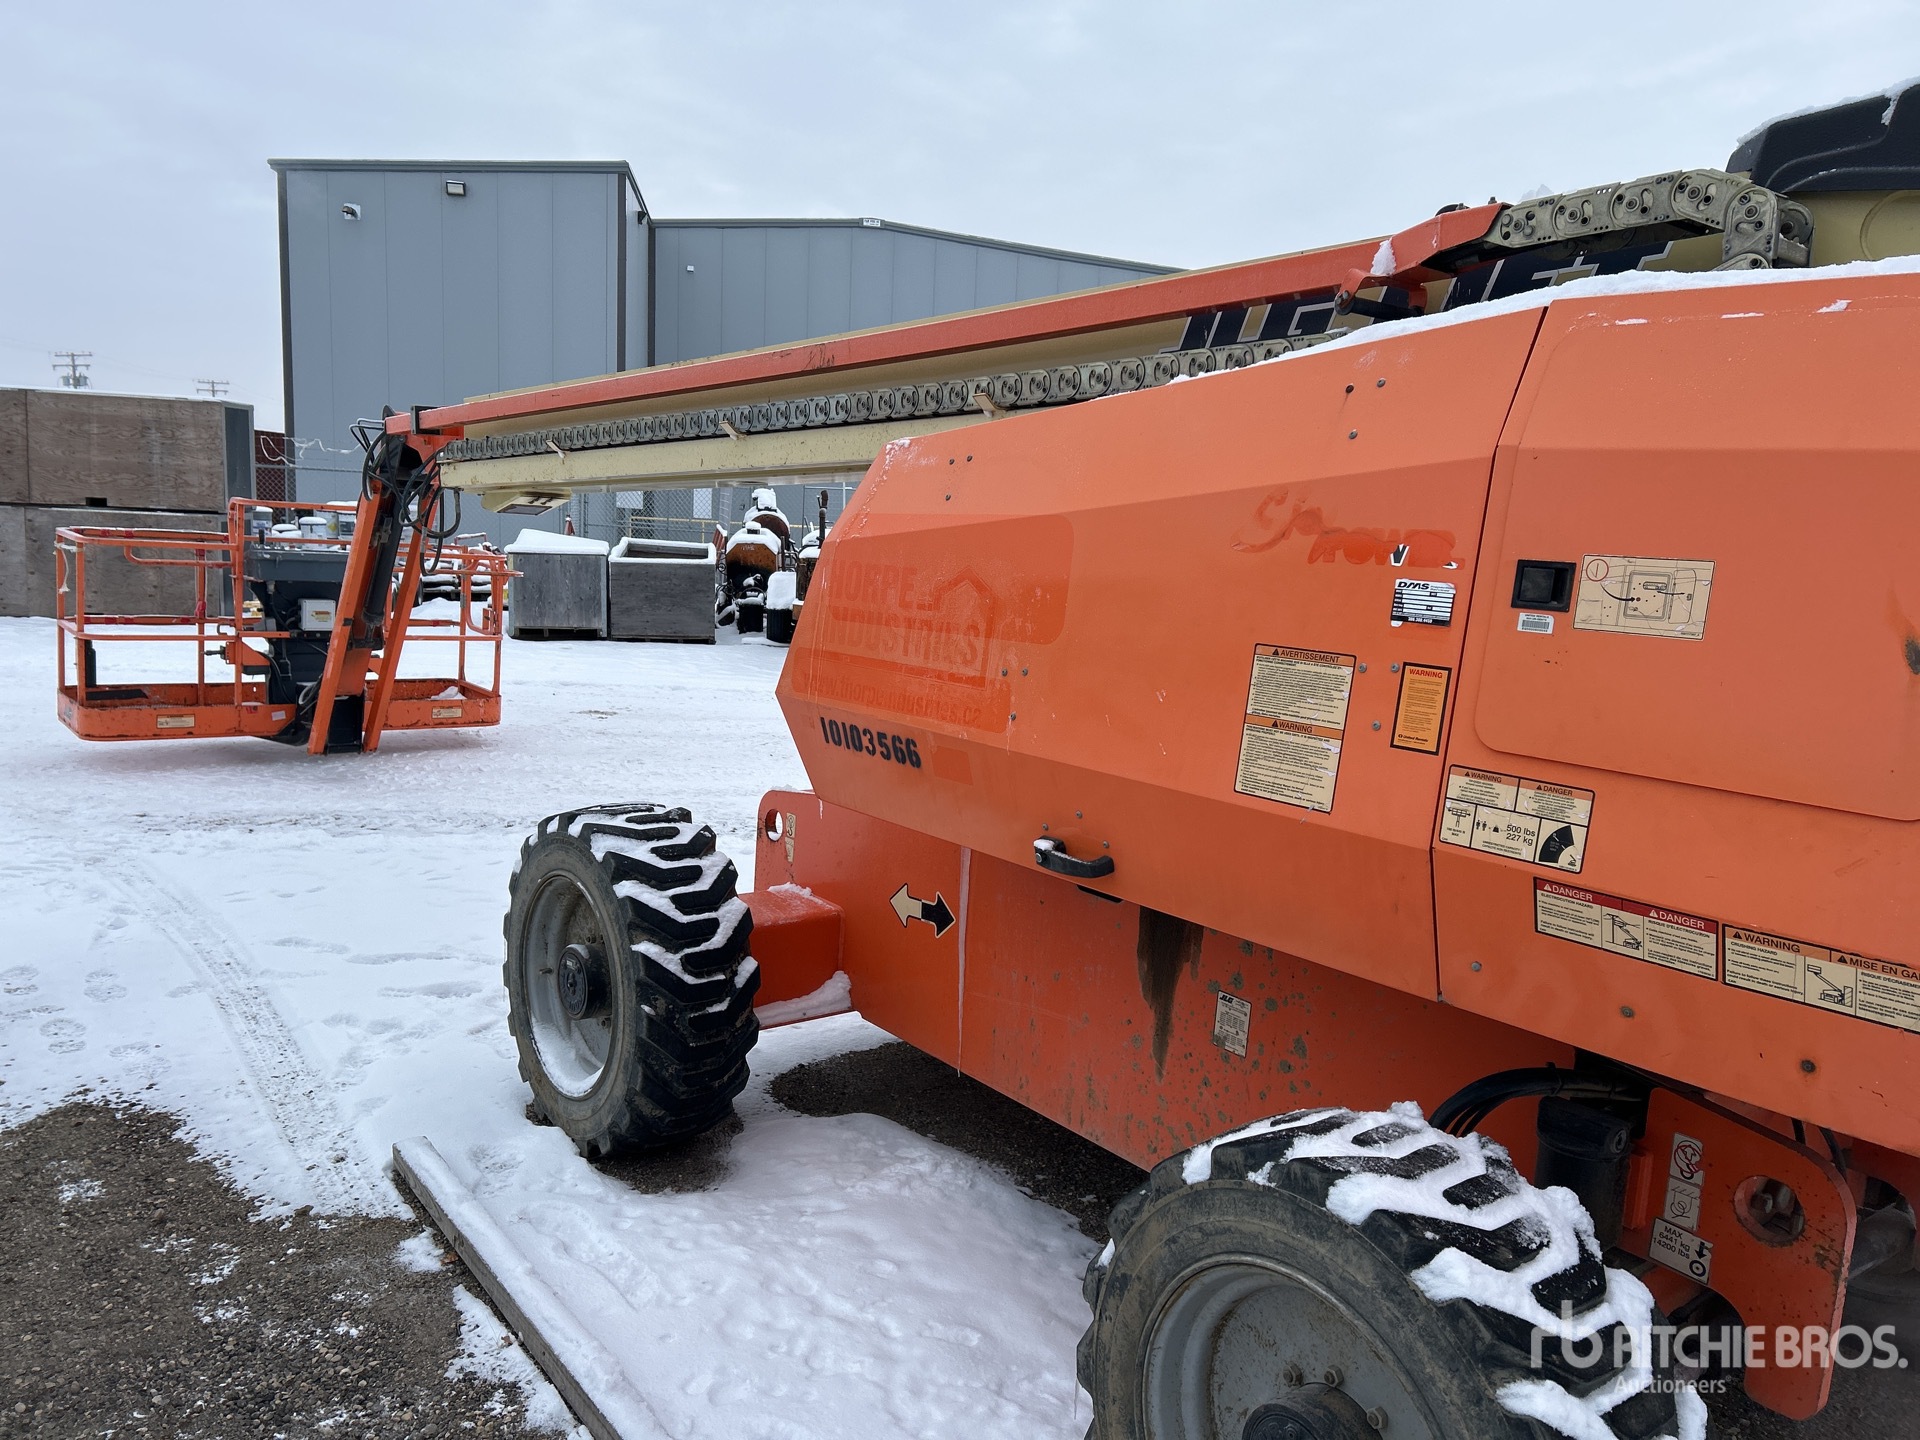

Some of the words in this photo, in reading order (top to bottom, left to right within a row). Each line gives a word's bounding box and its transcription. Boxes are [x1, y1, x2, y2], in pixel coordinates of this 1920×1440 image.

[1397, 581, 1430, 590] DMS
[1280, 649, 1340, 664] AVERTISSEMENT
[1409, 668, 1443, 679] WARNING
[1278, 720, 1313, 734] WARNING
[820, 716, 922, 769] 10103566
[1470, 771, 1502, 783] WARNING
[1543, 785, 1573, 796] DANGER
[1506, 824, 1522, 834] 500
[1523, 828, 1536, 837] lbs
[1506, 833, 1521, 842] 227
[1523, 836, 1533, 847] kg
[1552, 885, 1593, 902] DANGER
[1659, 911, 1705, 930] DANGER
[1744, 932, 1800, 953] WARNING
[1757, 946, 1778, 956] HAZARD
[1849, 957, 1878, 971] MISE
[1882, 964, 1898, 975] EN
[1219, 994, 1234, 1004] JLG
[1664, 1225, 1683, 1240] MAX
[1653, 1237, 1677, 1253] 14200
[1678, 1248, 1690, 1260] lbs
[1658, 1231, 1678, 1245] 6441
[1680, 1241, 1690, 1252] kg
